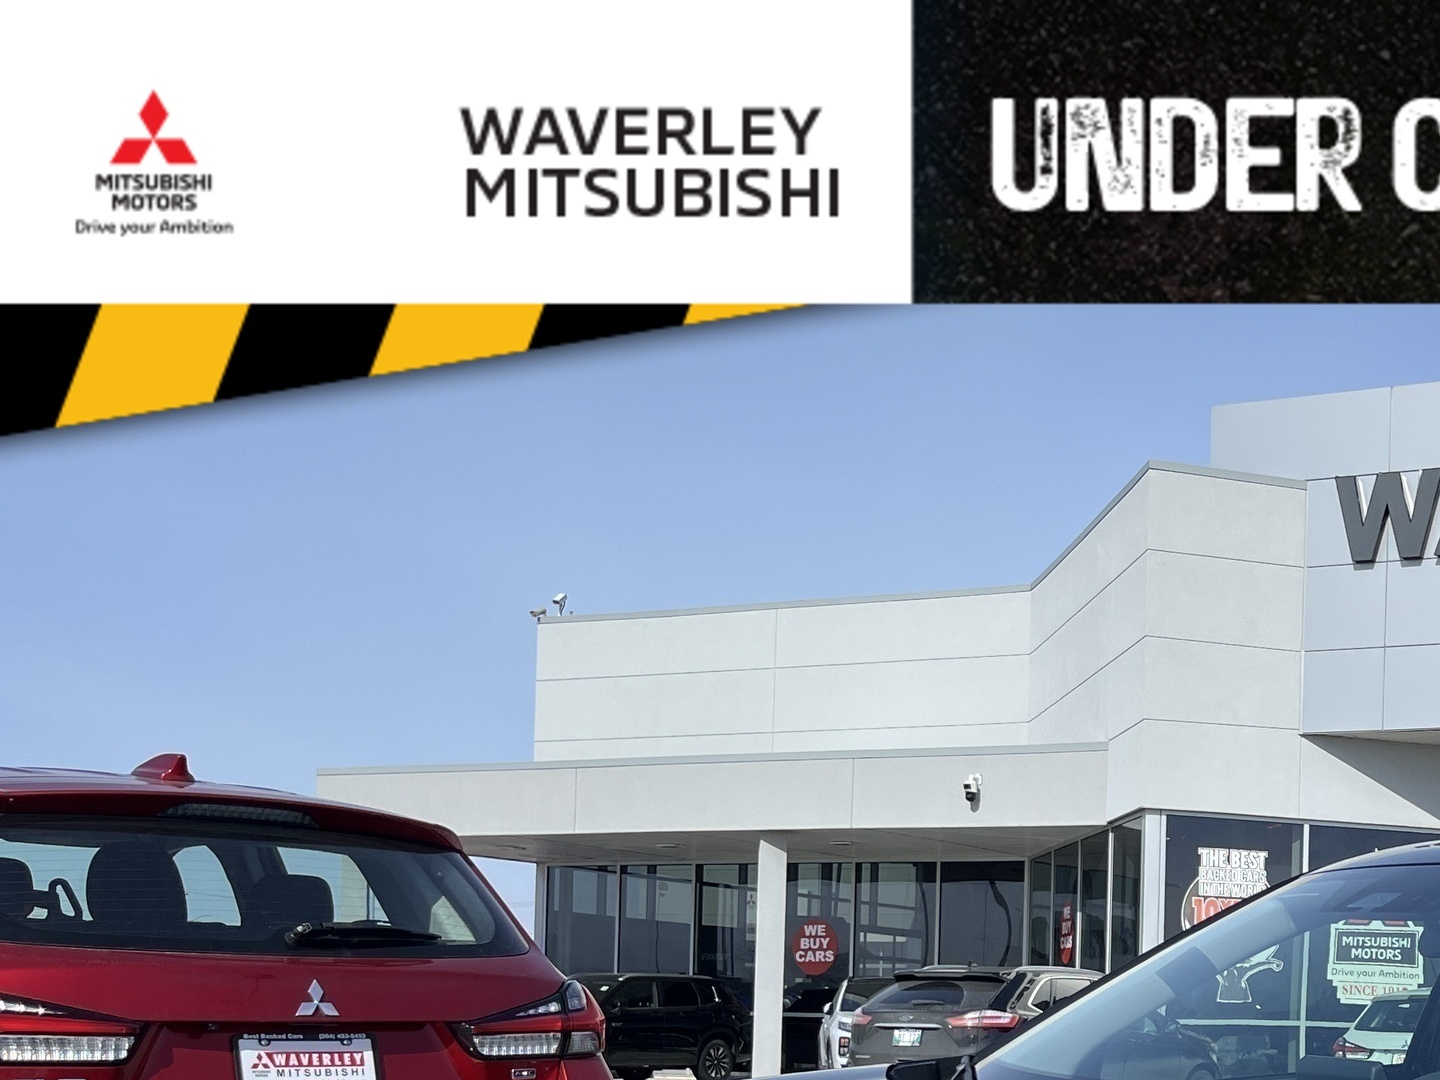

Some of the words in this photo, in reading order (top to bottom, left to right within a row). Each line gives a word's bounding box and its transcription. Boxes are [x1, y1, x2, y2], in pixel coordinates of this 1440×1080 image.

[1200, 848, 1228, 868] THE
[1230, 850, 1267, 870] BEST
[1201, 869, 1238, 881] BACKED
[1240, 870, 1266, 883] CARS
[1200, 882, 1210, 895] IN
[1210, 883, 1230, 895] THE
[804, 925, 826, 936] WE
[800, 938, 830, 949] BUY
[1342, 936, 1411, 948] MITSUBISHI
[796, 951, 834, 962] CARS
[1351, 948, 1401, 960] MOTORS
[1331, 968, 1355, 976] Drive
[1357, 970, 1377, 978] your
[1378, 970, 1420, 979] Ambition
[1342, 984, 1378, 996] SINCE
[273, 1053, 363, 1067] WAVERLEY
[276, 1068, 365, 1077] MITSUBISHI
